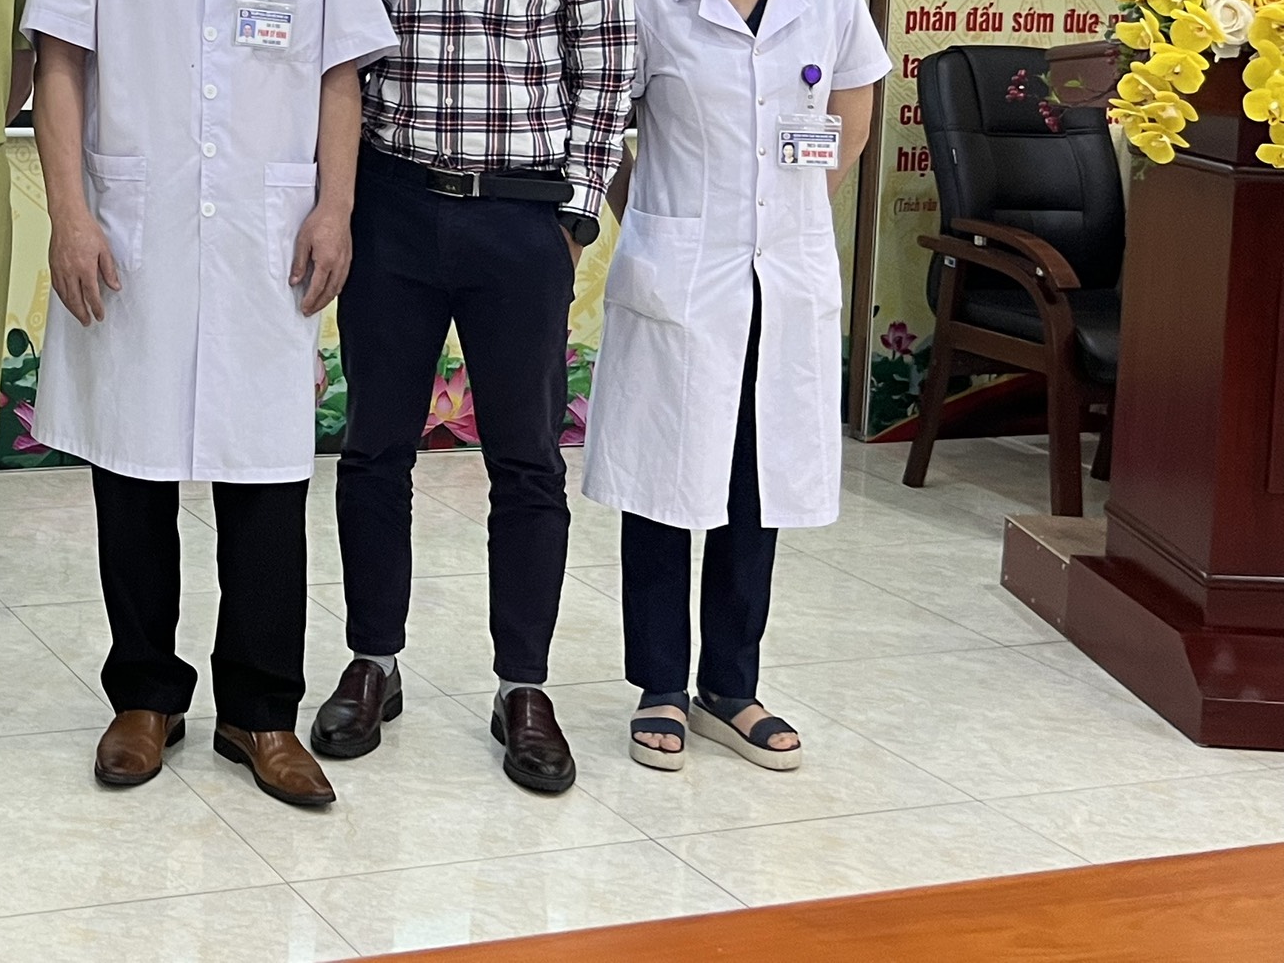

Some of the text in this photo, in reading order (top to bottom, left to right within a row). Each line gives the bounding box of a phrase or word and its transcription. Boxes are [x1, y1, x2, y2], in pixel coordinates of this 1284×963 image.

[905, 1, 957, 35] phấn
[965, 1, 1003, 33] đấu
[1012, 5, 1054, 33] sớm
[1063, 9, 1099, 33] đưa
[897, 146, 933, 177] hiệ
